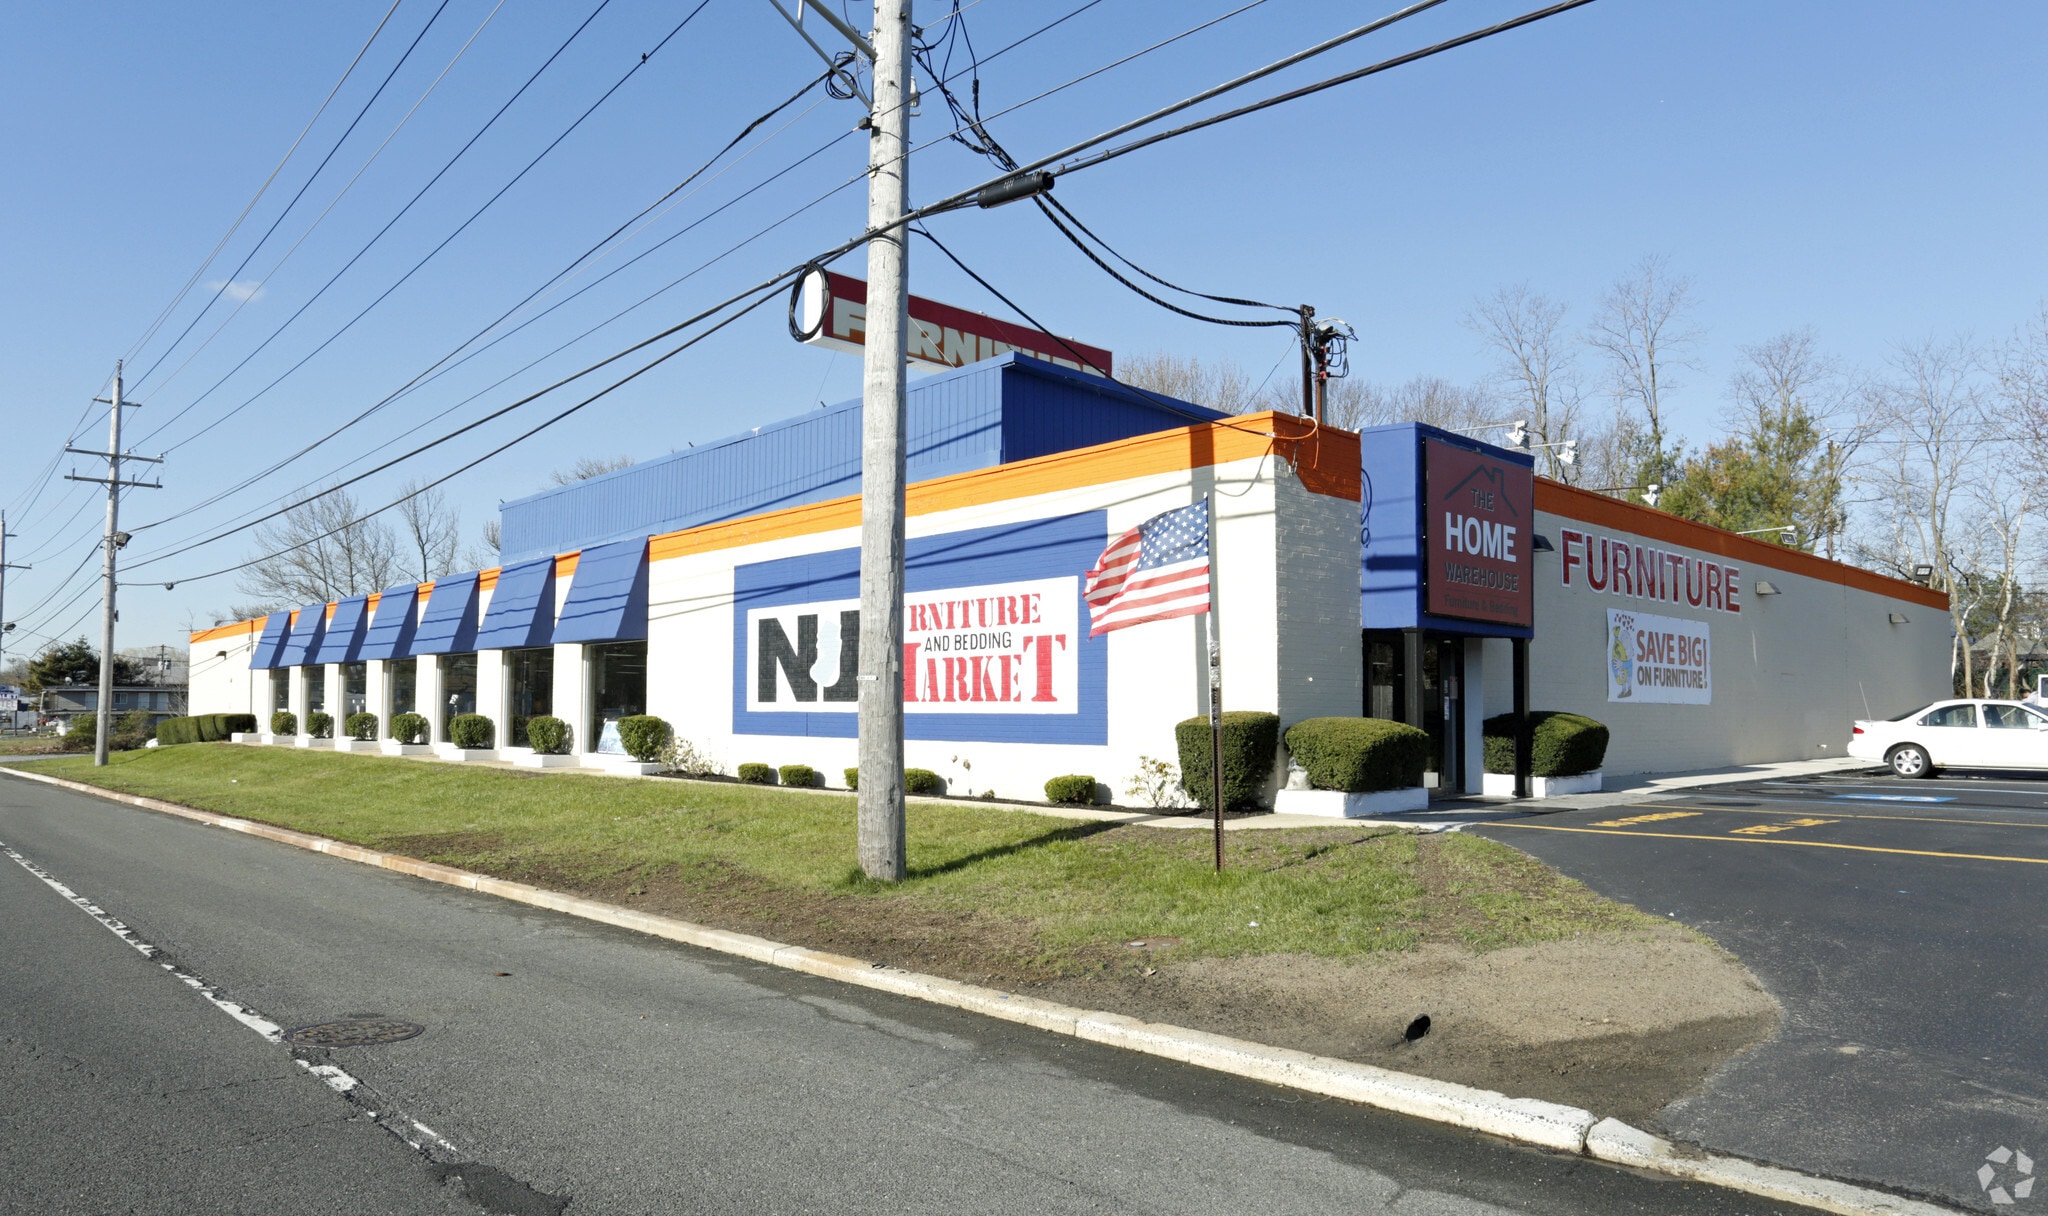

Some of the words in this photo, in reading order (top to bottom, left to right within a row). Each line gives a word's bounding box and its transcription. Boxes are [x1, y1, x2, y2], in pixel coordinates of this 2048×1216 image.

[1471, 488, 1495, 512] THE
[1445, 511, 1517, 563] HOME
[1444, 561, 1520, 593] WAREHOUSE
[1560, 527, 1741, 615] FURNITURE
[904, 593, 1041, 632] RNITURE
[758, 609, 860, 703] NJ
[924, 634, 950, 653] AND
[954, 631, 1012, 652] BEDDING
[1636, 629, 1676, 665] SAVE
[1637, 665, 1652, 687] ON
